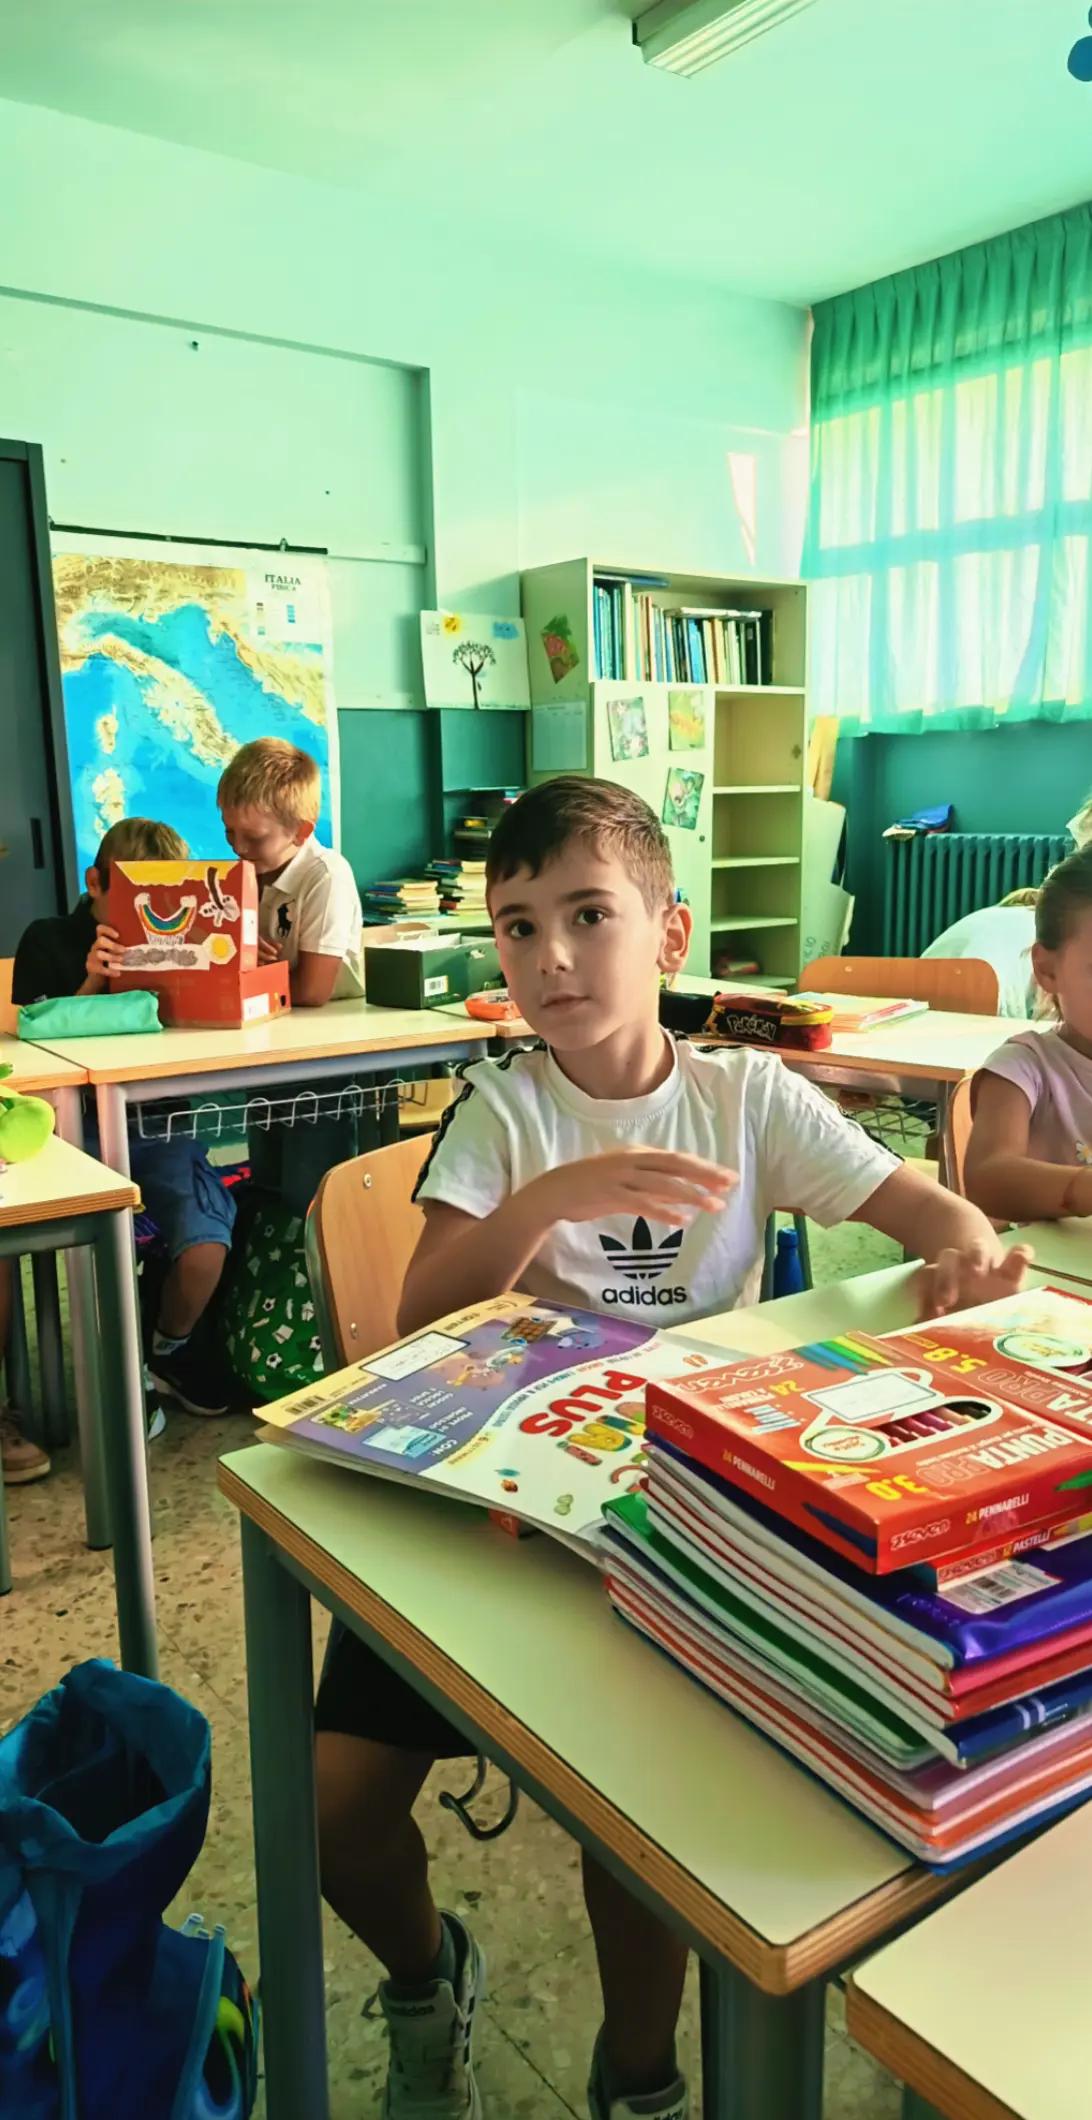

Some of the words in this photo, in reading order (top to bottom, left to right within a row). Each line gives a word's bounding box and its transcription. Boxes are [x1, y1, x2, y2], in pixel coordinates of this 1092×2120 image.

[265, 574, 301, 585] ITALIA
[601, 1285, 688, 1306] adidas
[922, 1346, 988, 1374] 5.8
[519, 1369, 648, 1437] PLUS
[732, 1455, 777, 1490] PENNARELLI
[864, 1474, 930, 1501] 3.0
[978, 1493, 1030, 1520] PENNARELLI
[1013, 1529, 1051, 1553] PASTELLI
